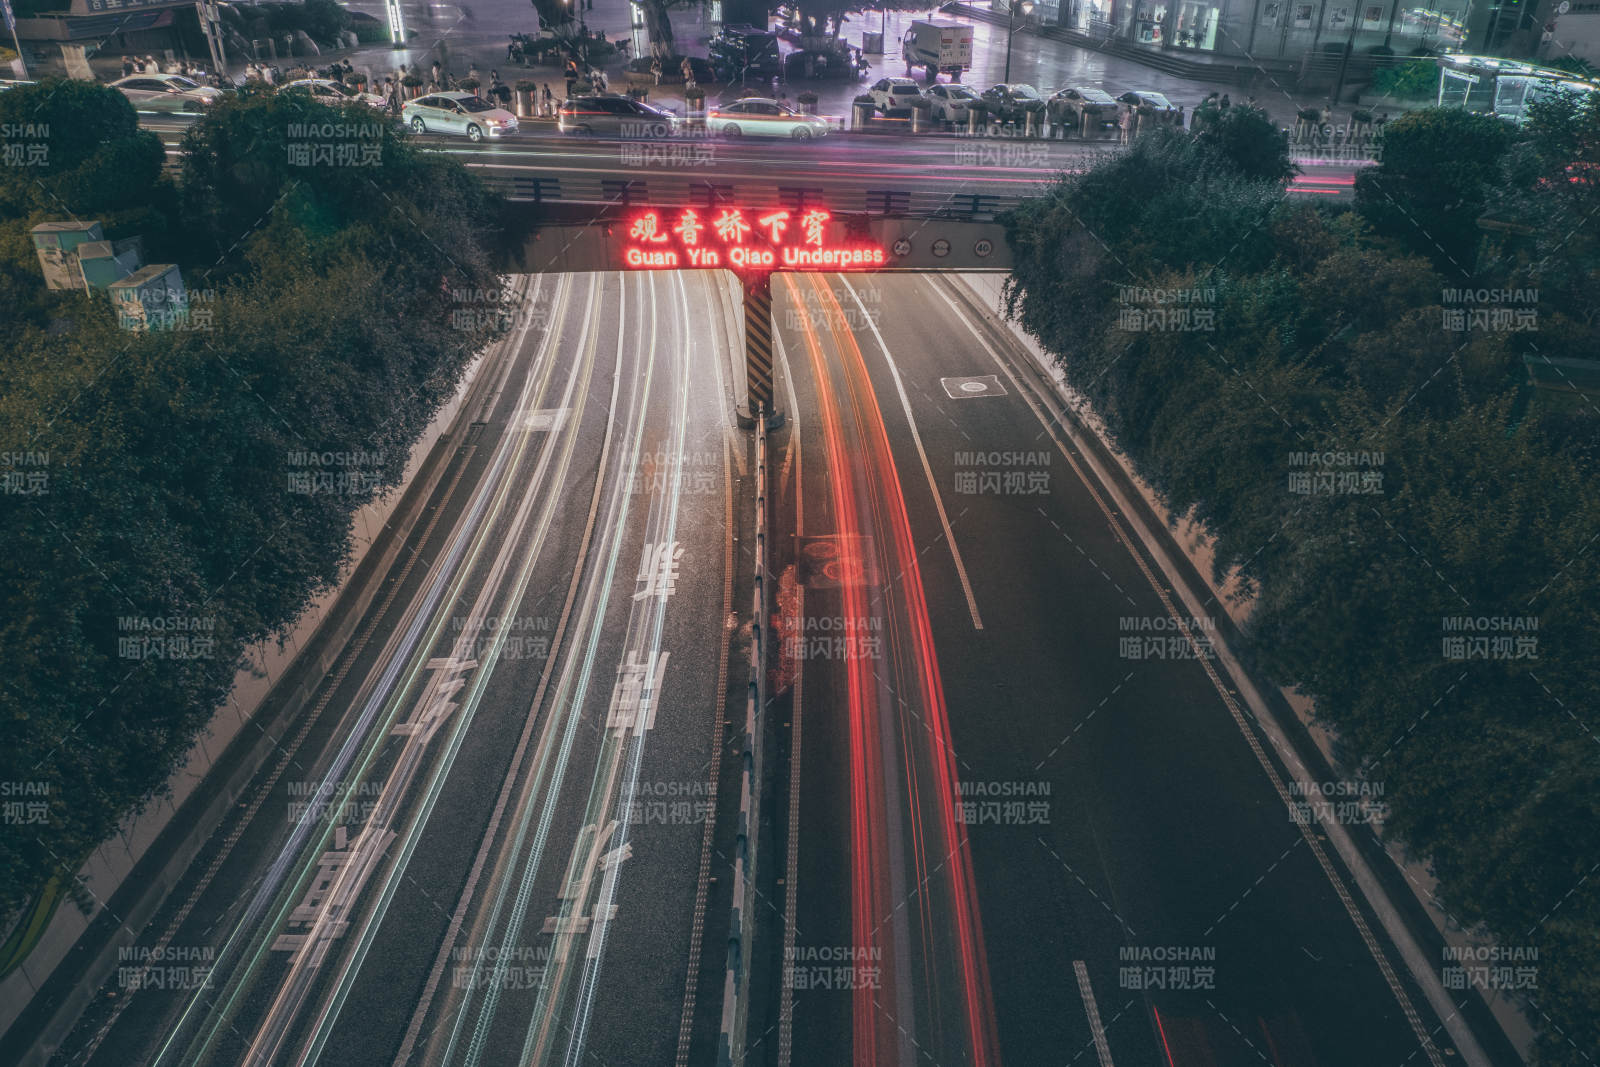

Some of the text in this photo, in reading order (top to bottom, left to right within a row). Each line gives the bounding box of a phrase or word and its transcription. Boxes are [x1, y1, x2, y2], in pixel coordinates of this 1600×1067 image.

[630, 209, 830, 245] 观音桥下穿
[627, 248, 884, 268] Guan Yin Qiao Underpass
